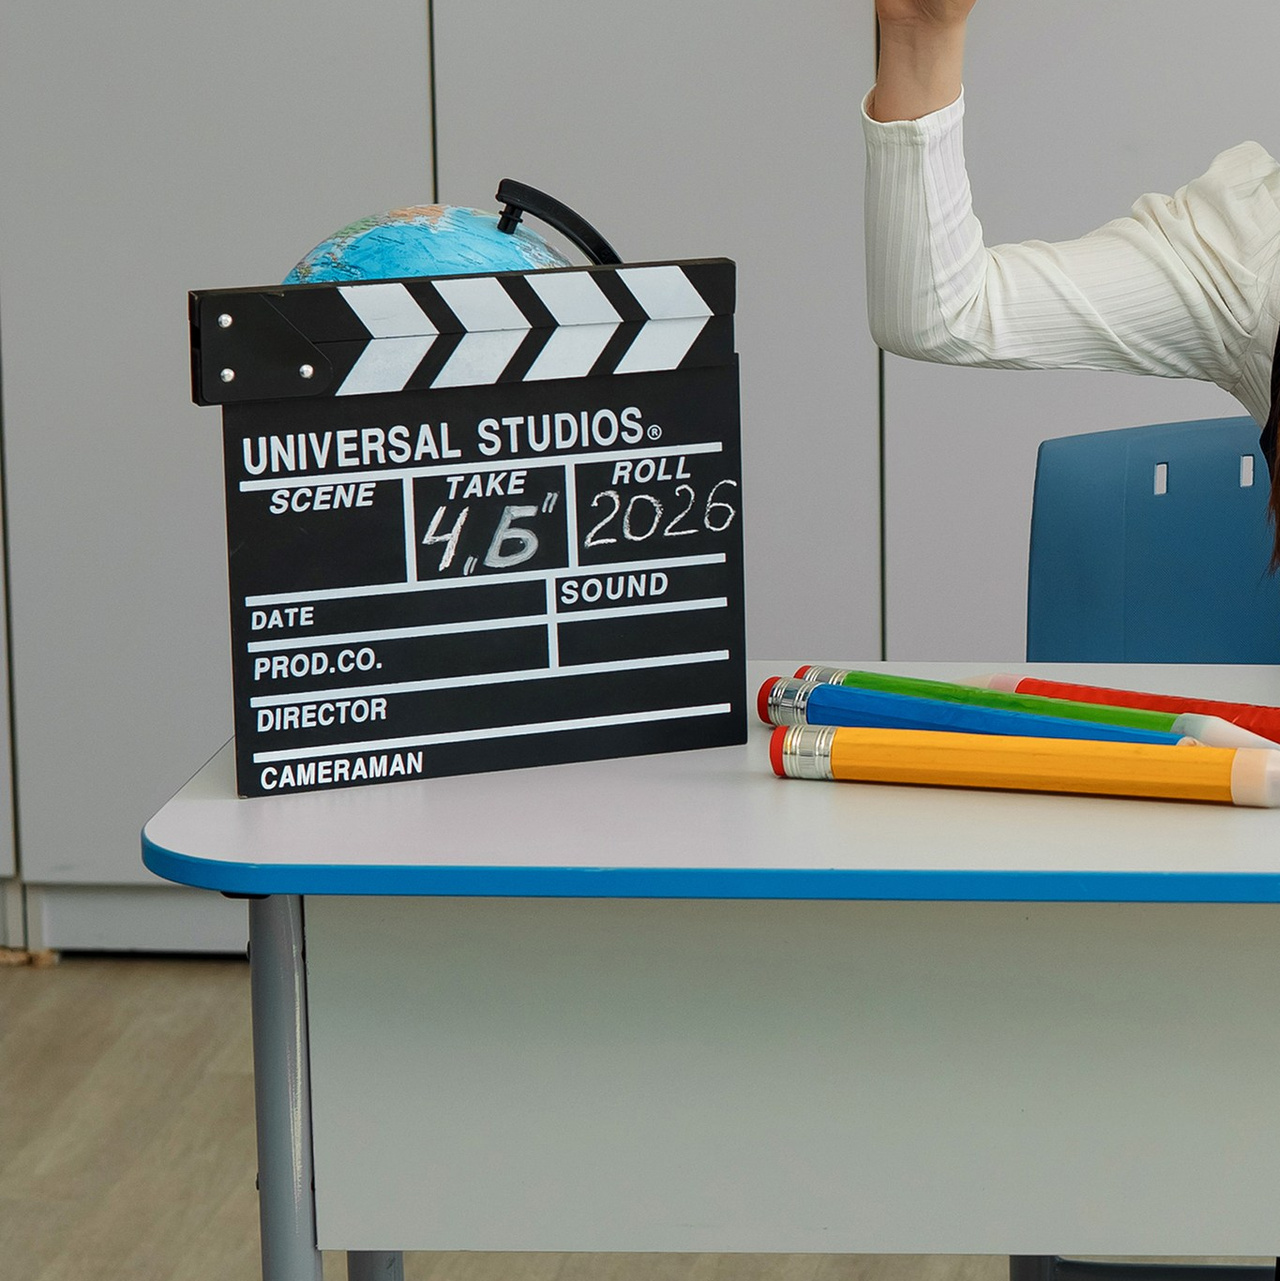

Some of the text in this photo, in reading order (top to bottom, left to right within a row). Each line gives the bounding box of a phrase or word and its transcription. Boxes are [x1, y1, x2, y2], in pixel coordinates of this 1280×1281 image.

[243, 423, 462, 475] UNIVERSAL
[447, 471, 528, 500] TAKE
[612, 457, 692, 485] ROLL
[270, 483, 377, 515] SCENE
[584, 480, 738, 548] 2026
[561, 573, 669, 605] SOUND
[252, 607, 315, 630] DATE
[255, 648, 383, 681] PROD.CO.
[258, 698, 388, 732] DIRECTOR
[261, 752, 423, 790] CAMERAMAN
